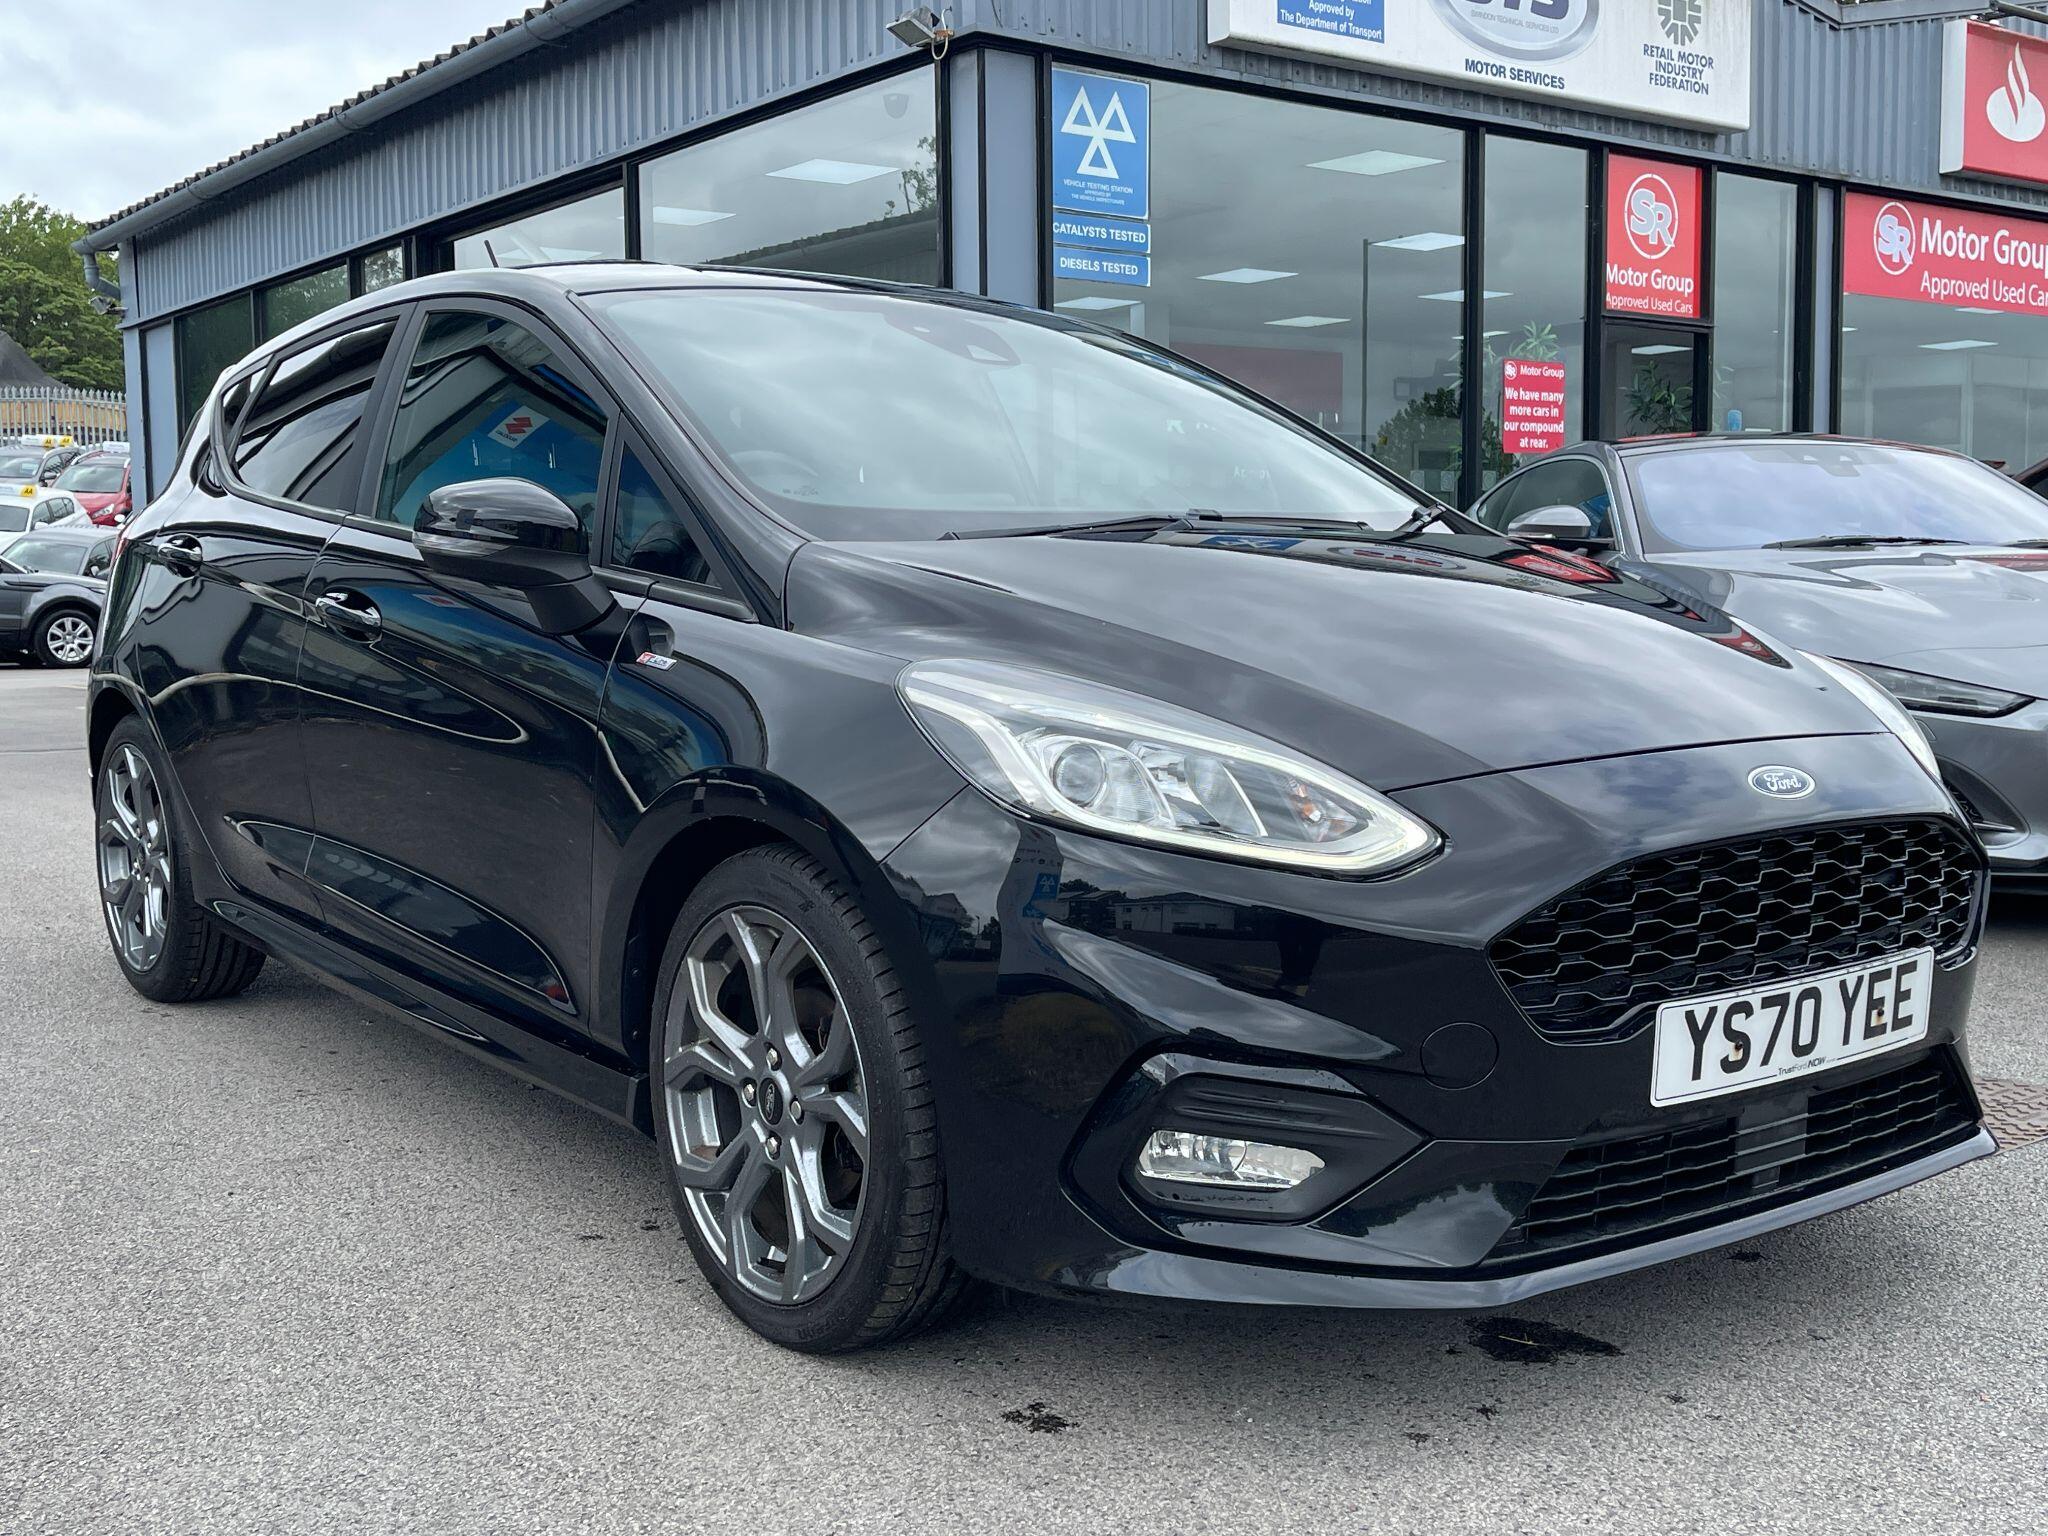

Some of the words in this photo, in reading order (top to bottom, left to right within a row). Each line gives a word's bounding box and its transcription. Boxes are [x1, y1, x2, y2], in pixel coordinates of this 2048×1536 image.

[1308, 1, 1344, 16] Approved
[1345, 6, 1355, 20] by
[1280, 9, 1295, 22] The
[1296, 13, 1338, 31] Department
[1339, 22, 1349, 32] of
[1348, 23, 1383, 40] Transport
[1643, 44, 1674, 62] RETAIL
[1677, 51, 1714, 70] MOTOR
[1465, 59, 1506, 79] MOTOR
[1509, 67, 1565, 90] SERVICES
[1655, 60, 1704, 81] INDUSTRY
[1649, 73, 1709, 95] FEDERATION
[1063, 179, 1086, 189] VEHICLE
[1087, 182, 1110, 192] TESTING
[1110, 185, 1134, 195] STATION
[1631, 188, 1675, 247] SR
[1053, 222, 1107, 239] CATALYSTS
[1109, 229, 1146, 244] TESTED
[1878, 214, 1913, 264] SR
[1921, 217, 1989, 261] Motor
[1060, 257, 1100, 272] DIESELS
[1102, 261, 1139, 276] TESTED
[1606, 262, 1649, 288] Motor
[1651, 269, 1694, 297] Group
[1920, 270, 1989, 300] Approved
[1992, 279, 2026, 305] Used
[1606, 292, 1649, 310] Approved
[1651, 297, 1673, 312] Used
[1675, 300, 1693, 314] Cars
[1520, 365, 1542, 377] Motor
[1542, 366, 1564, 380] Group
[1505, 386, 1519, 400] We
[1519, 387, 1540, 401] have
[1541, 391, 1564, 406] many
[1509, 405, 1531, 416] more
[1532, 406, 1550, 418] cars
[1550, 405, 1560, 418] in
[1504, 421, 1519, 432] our
[1520, 420, 1564, 435] compound
[1519, 437, 1529, 449] at
[1529, 438, 1549, 449] rear.
[1763, 772, 1802, 792] Ford
[1684, 985, 1822, 1081] YS70
[1839, 960, 1918, 1046] YEE
